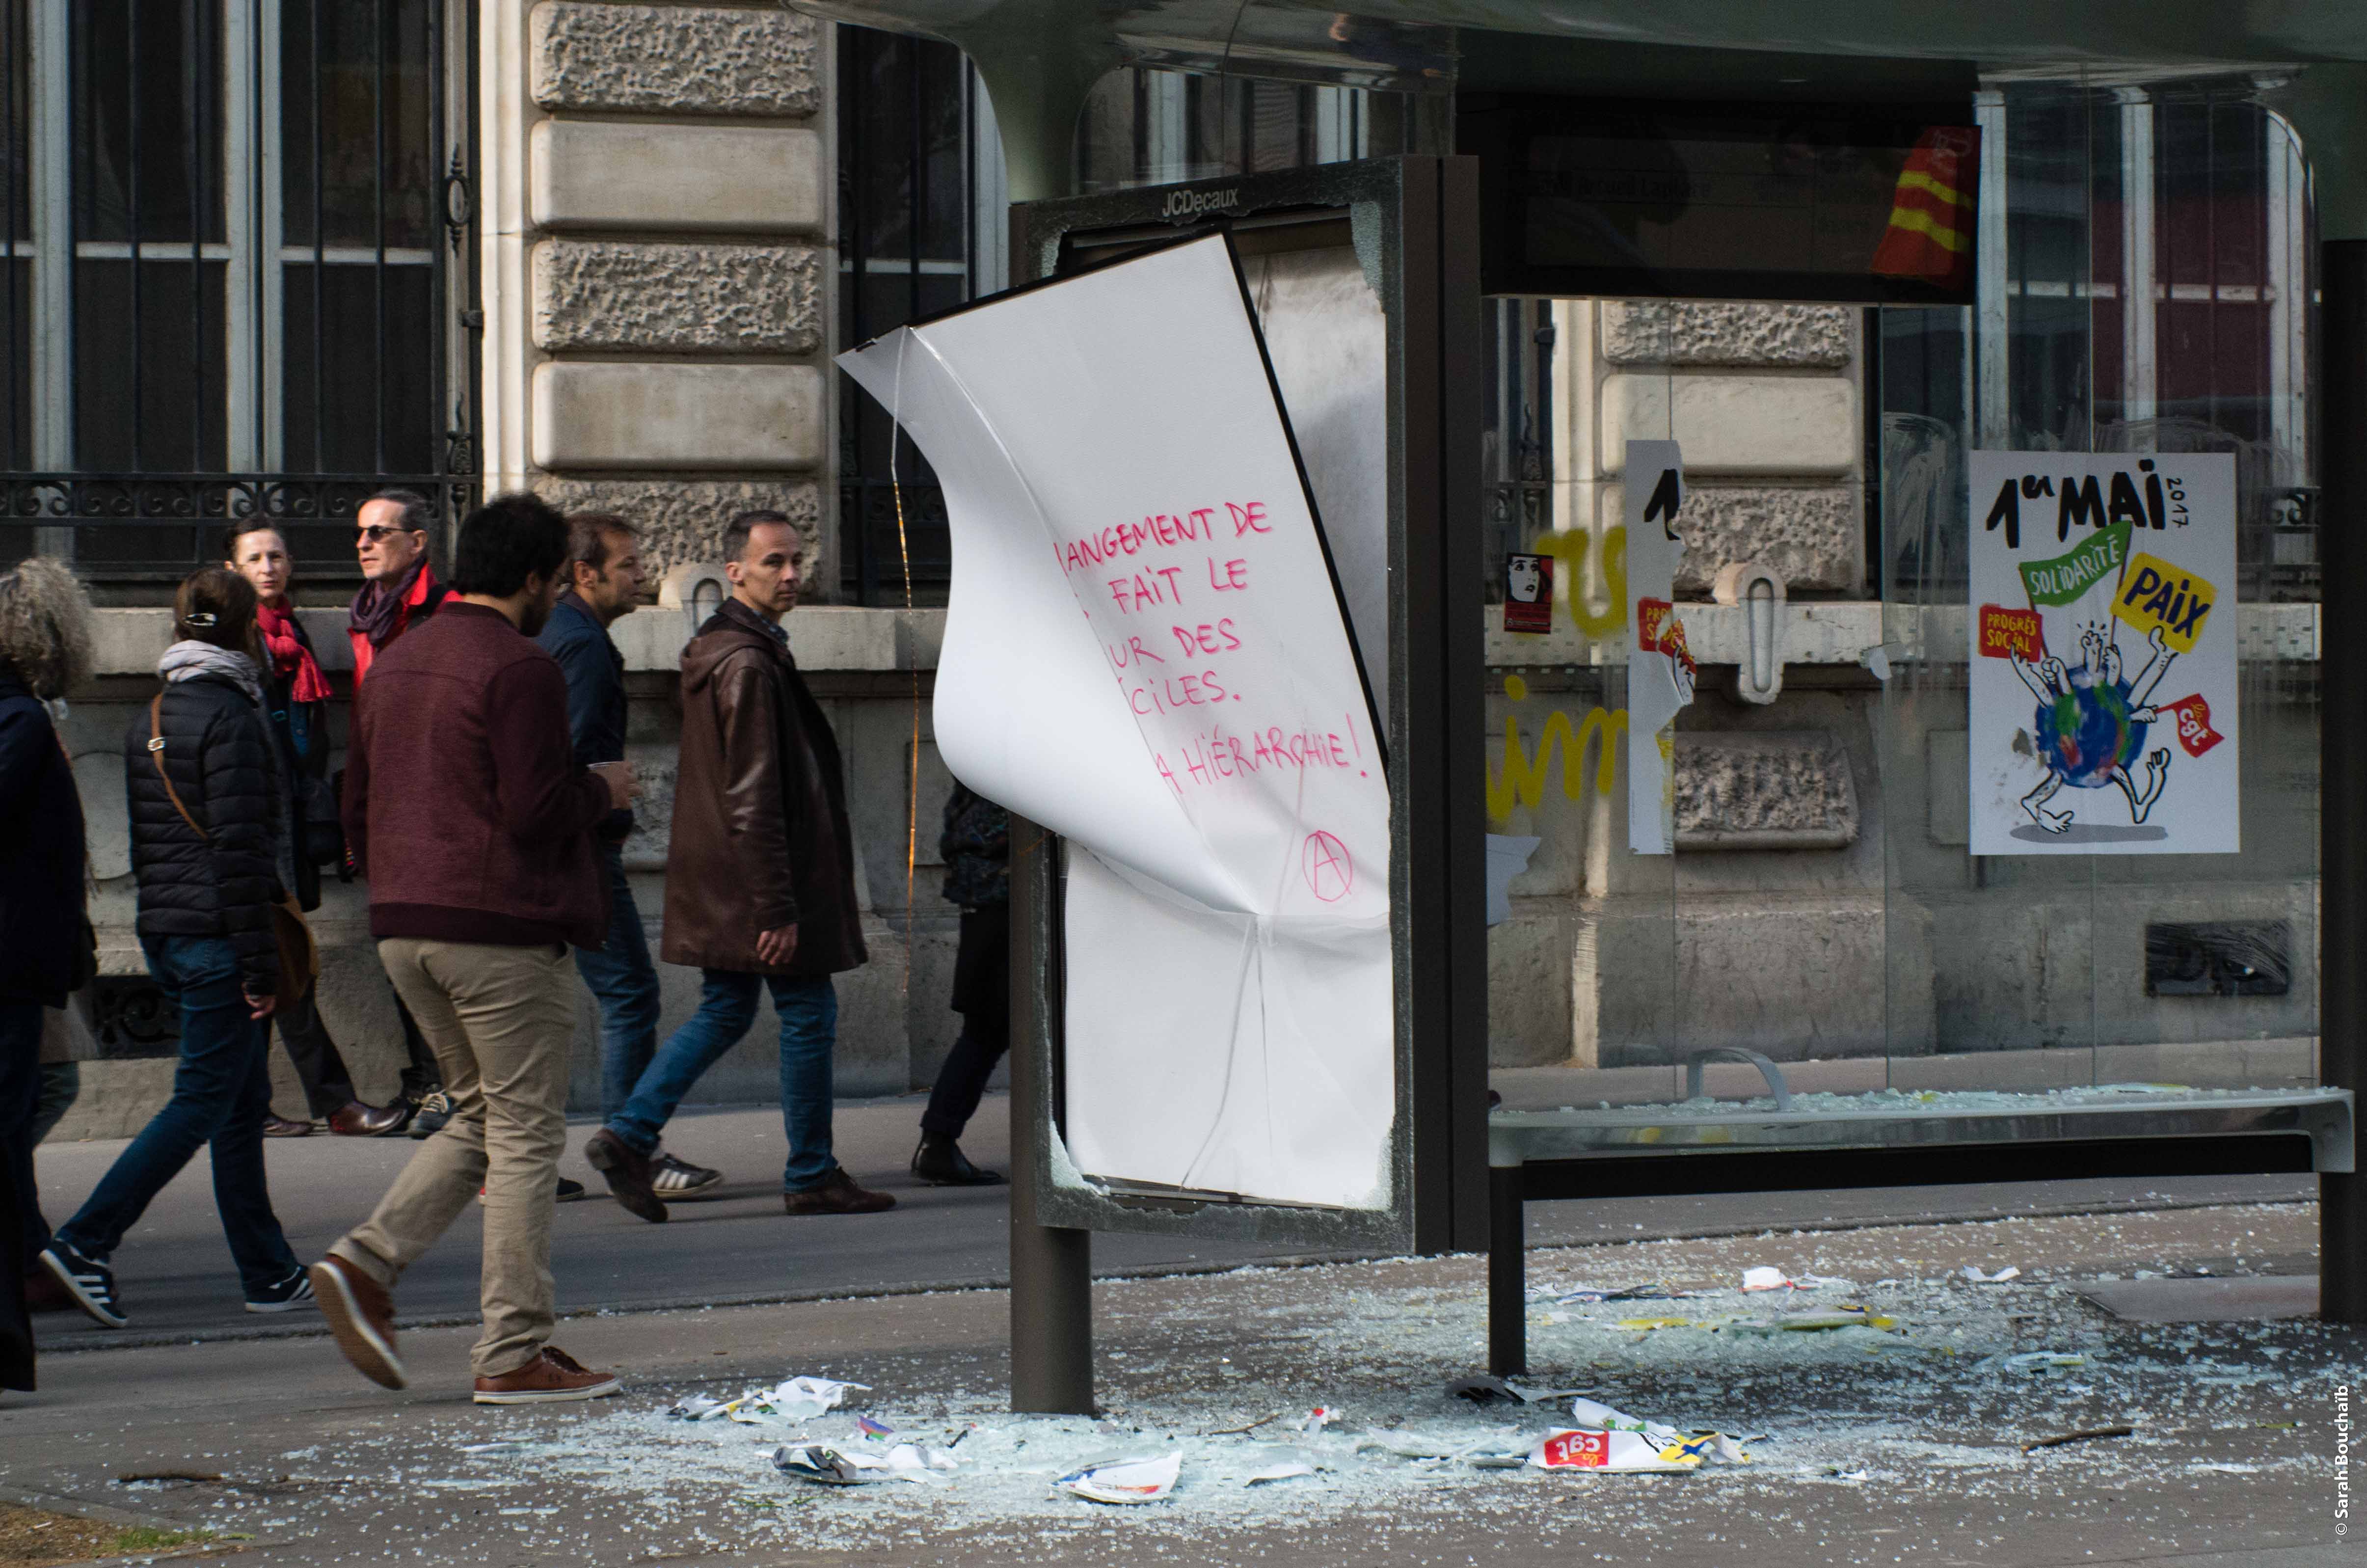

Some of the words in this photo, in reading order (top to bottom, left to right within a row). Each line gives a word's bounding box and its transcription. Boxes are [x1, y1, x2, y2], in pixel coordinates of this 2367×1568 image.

[1162, 189, 1238, 217] JCDecaux
[1225, 502, 1272, 537] DE
[2166, 477, 2189, 529] 2017
[1207, 557, 1249, 590] LE
[1109, 636, 1165, 668] UR
[1172, 618, 1241, 658] DES
[2180, 708, 2207, 746] cgt
[1556, 1434, 1600, 1461] cgt
